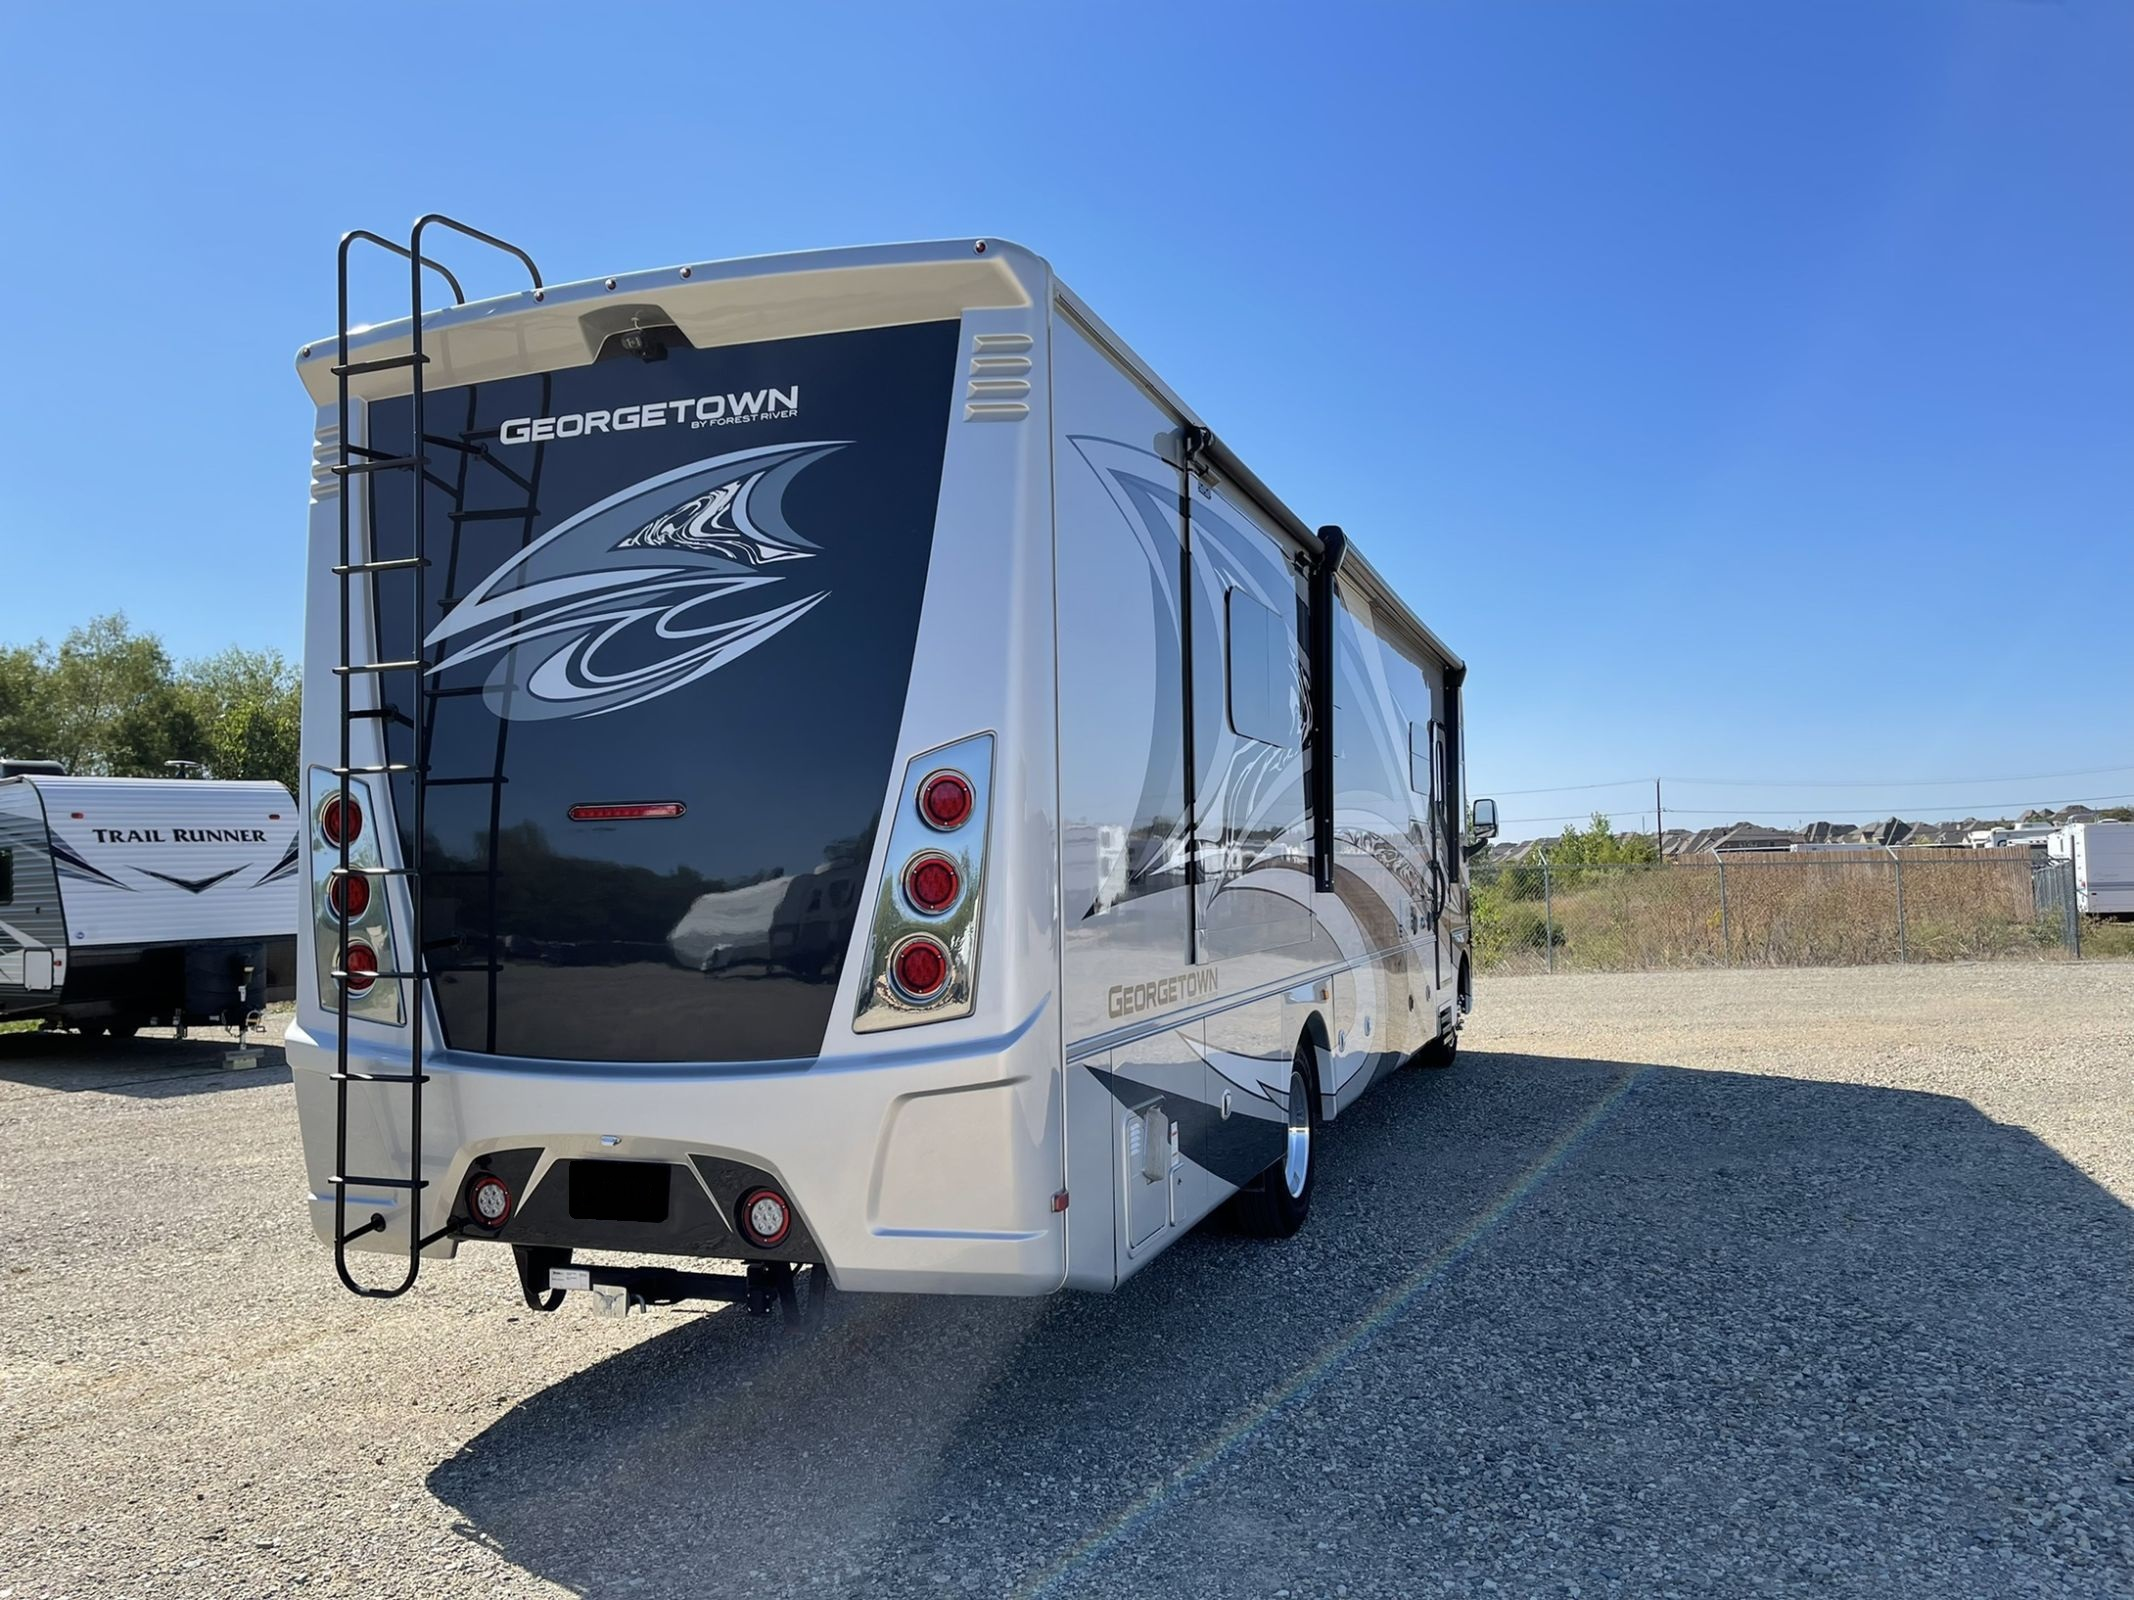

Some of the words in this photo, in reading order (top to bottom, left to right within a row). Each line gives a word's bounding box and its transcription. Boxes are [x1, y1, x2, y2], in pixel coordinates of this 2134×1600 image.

[500, 385, 798, 445] GEORGETOWN
[690, 420, 708, 429] BY
[709, 414, 759, 427] FOREST
[760, 409, 798, 421] RIVER
[92, 828, 166, 843] TRAIL
[172, 828, 267, 843] RUNNER
[1108, 967, 1218, 1018] GEORGETOWN
